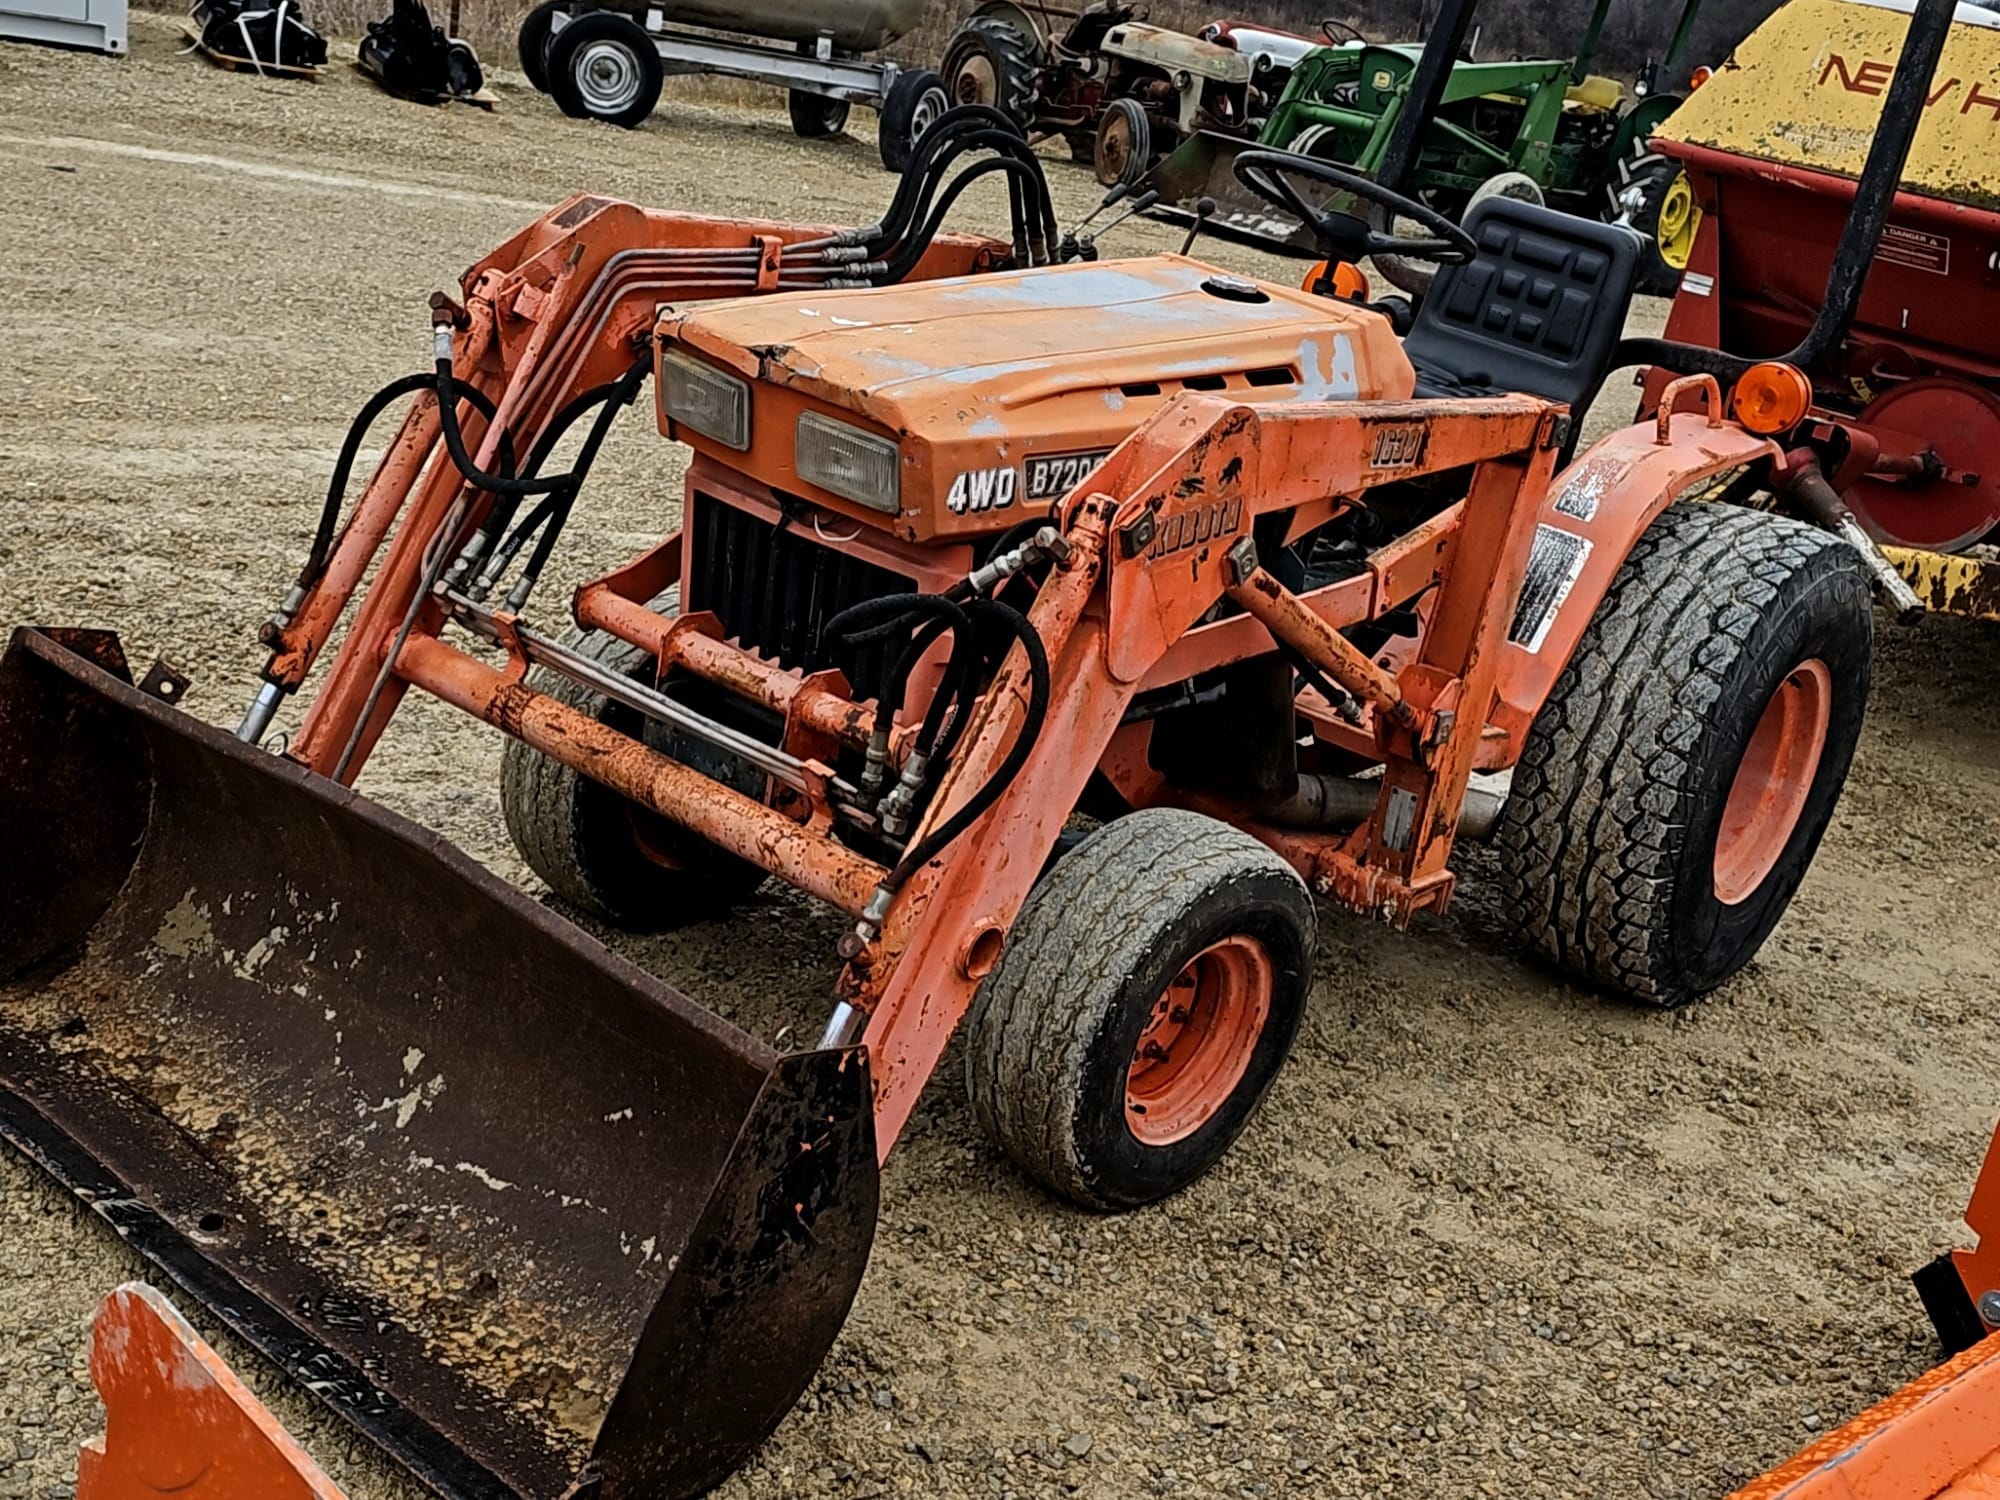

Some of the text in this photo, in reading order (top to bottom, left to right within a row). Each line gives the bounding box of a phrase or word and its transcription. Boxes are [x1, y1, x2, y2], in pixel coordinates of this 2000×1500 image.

[1889, 228, 1927, 243] DANGER
[946, 466, 1017, 514] 4WD
[1147, 497, 1243, 560] KUBOTA
